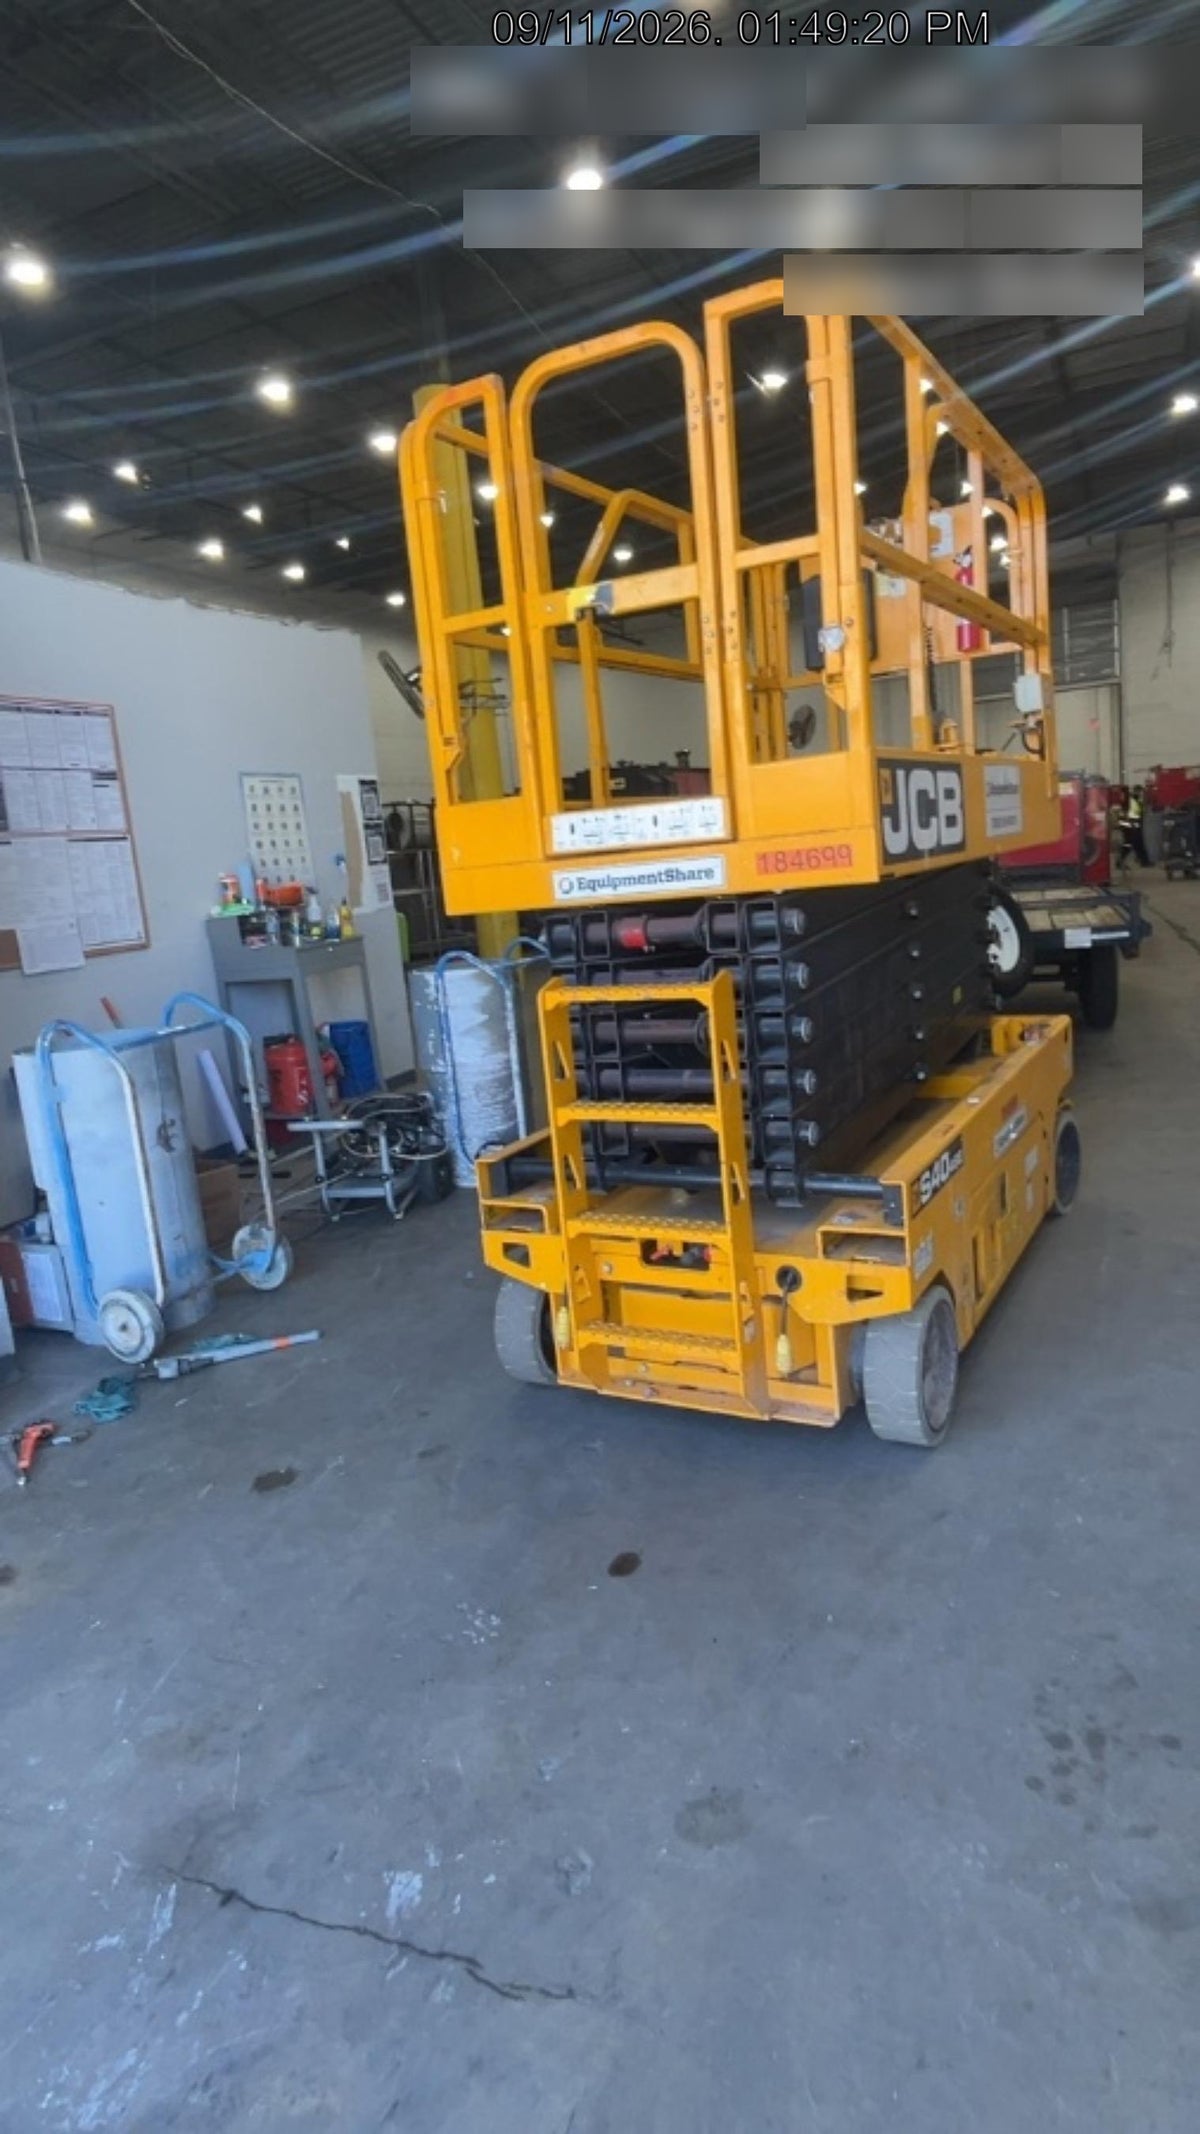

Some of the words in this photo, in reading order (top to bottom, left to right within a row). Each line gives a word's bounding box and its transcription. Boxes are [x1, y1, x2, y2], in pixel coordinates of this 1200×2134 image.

[882, 768, 964, 854] JCB
[757, 843, 853, 874] 184699
[576, 866, 715, 892] EquipmentShare
